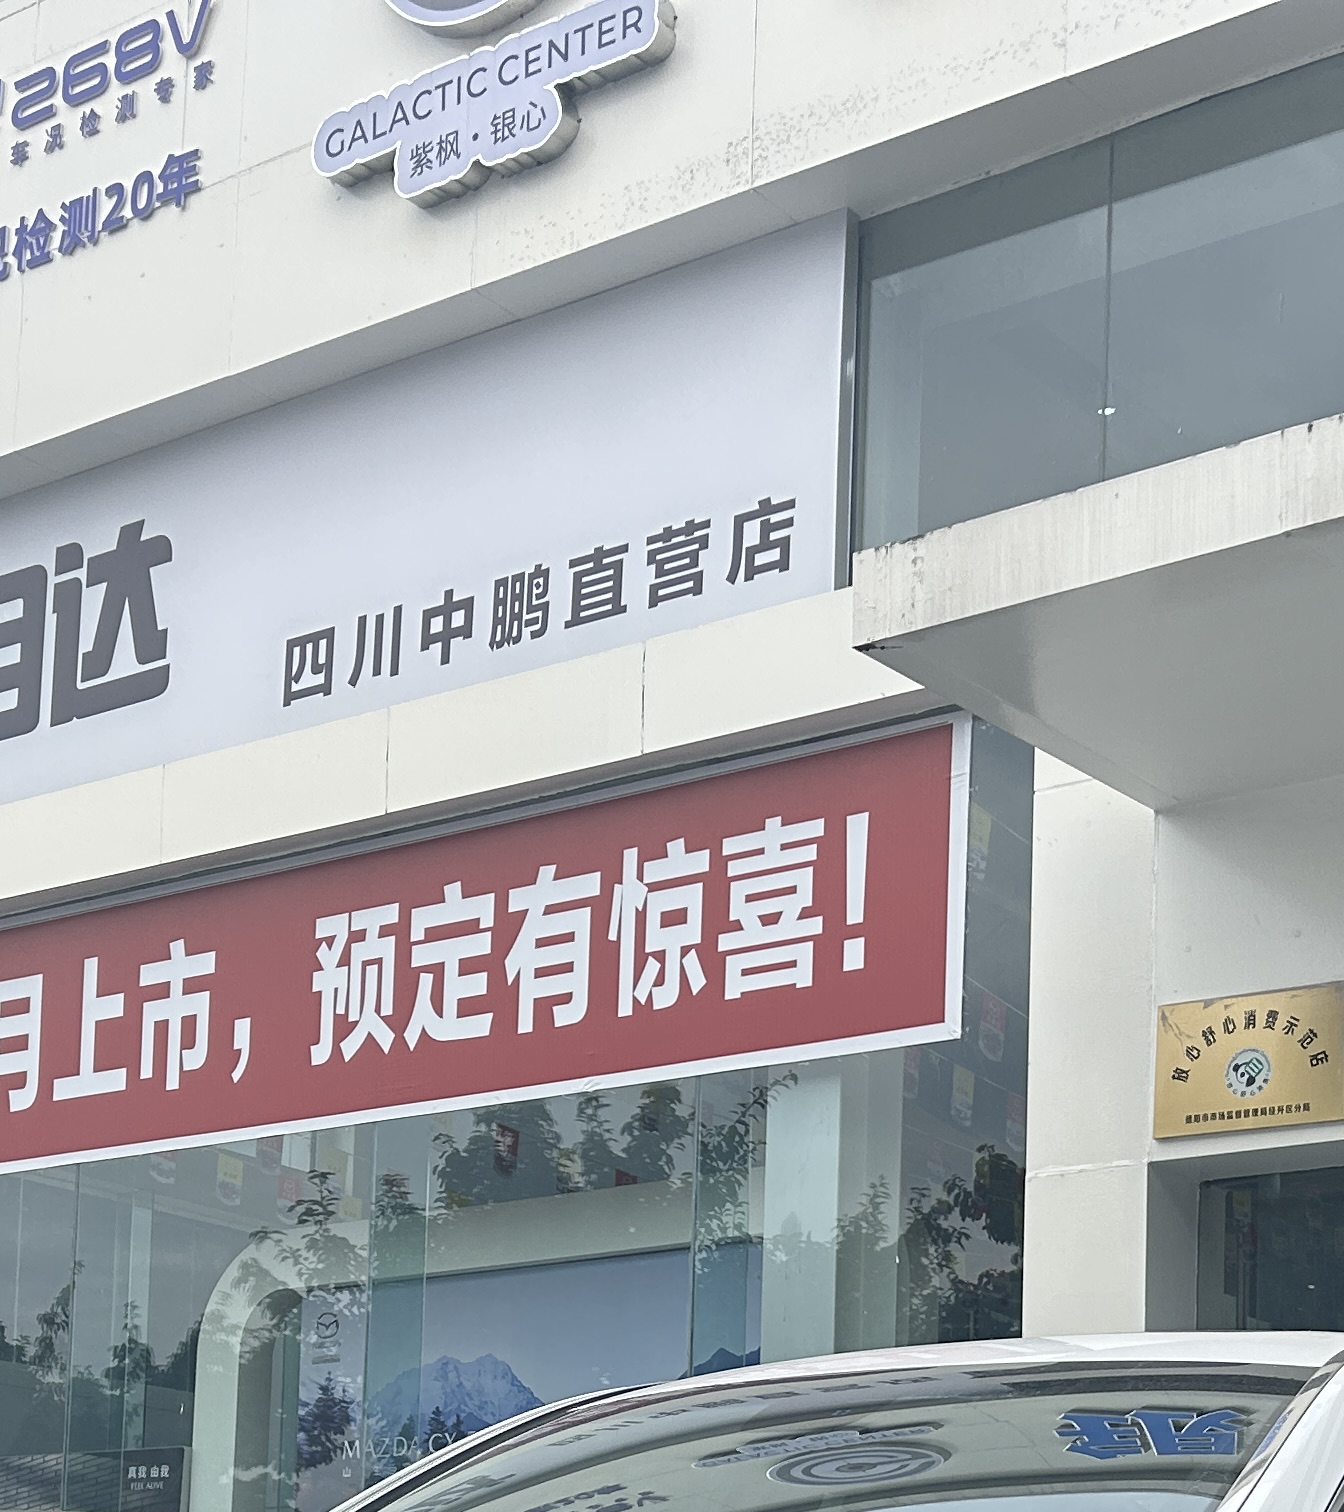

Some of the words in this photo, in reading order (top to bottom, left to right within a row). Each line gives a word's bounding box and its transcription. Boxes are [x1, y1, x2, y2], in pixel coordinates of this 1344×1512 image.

[10, 0, 213, 131] 268V
[10, 60, 215, 167] 车况检测专家
[325, 66, 489, 160] GALACTIC
[496, 4, 645, 88] CENTER
[282, 495, 797, 708] 四川中鹏直营店
[341, 1435, 421, 1461] MAZDA
